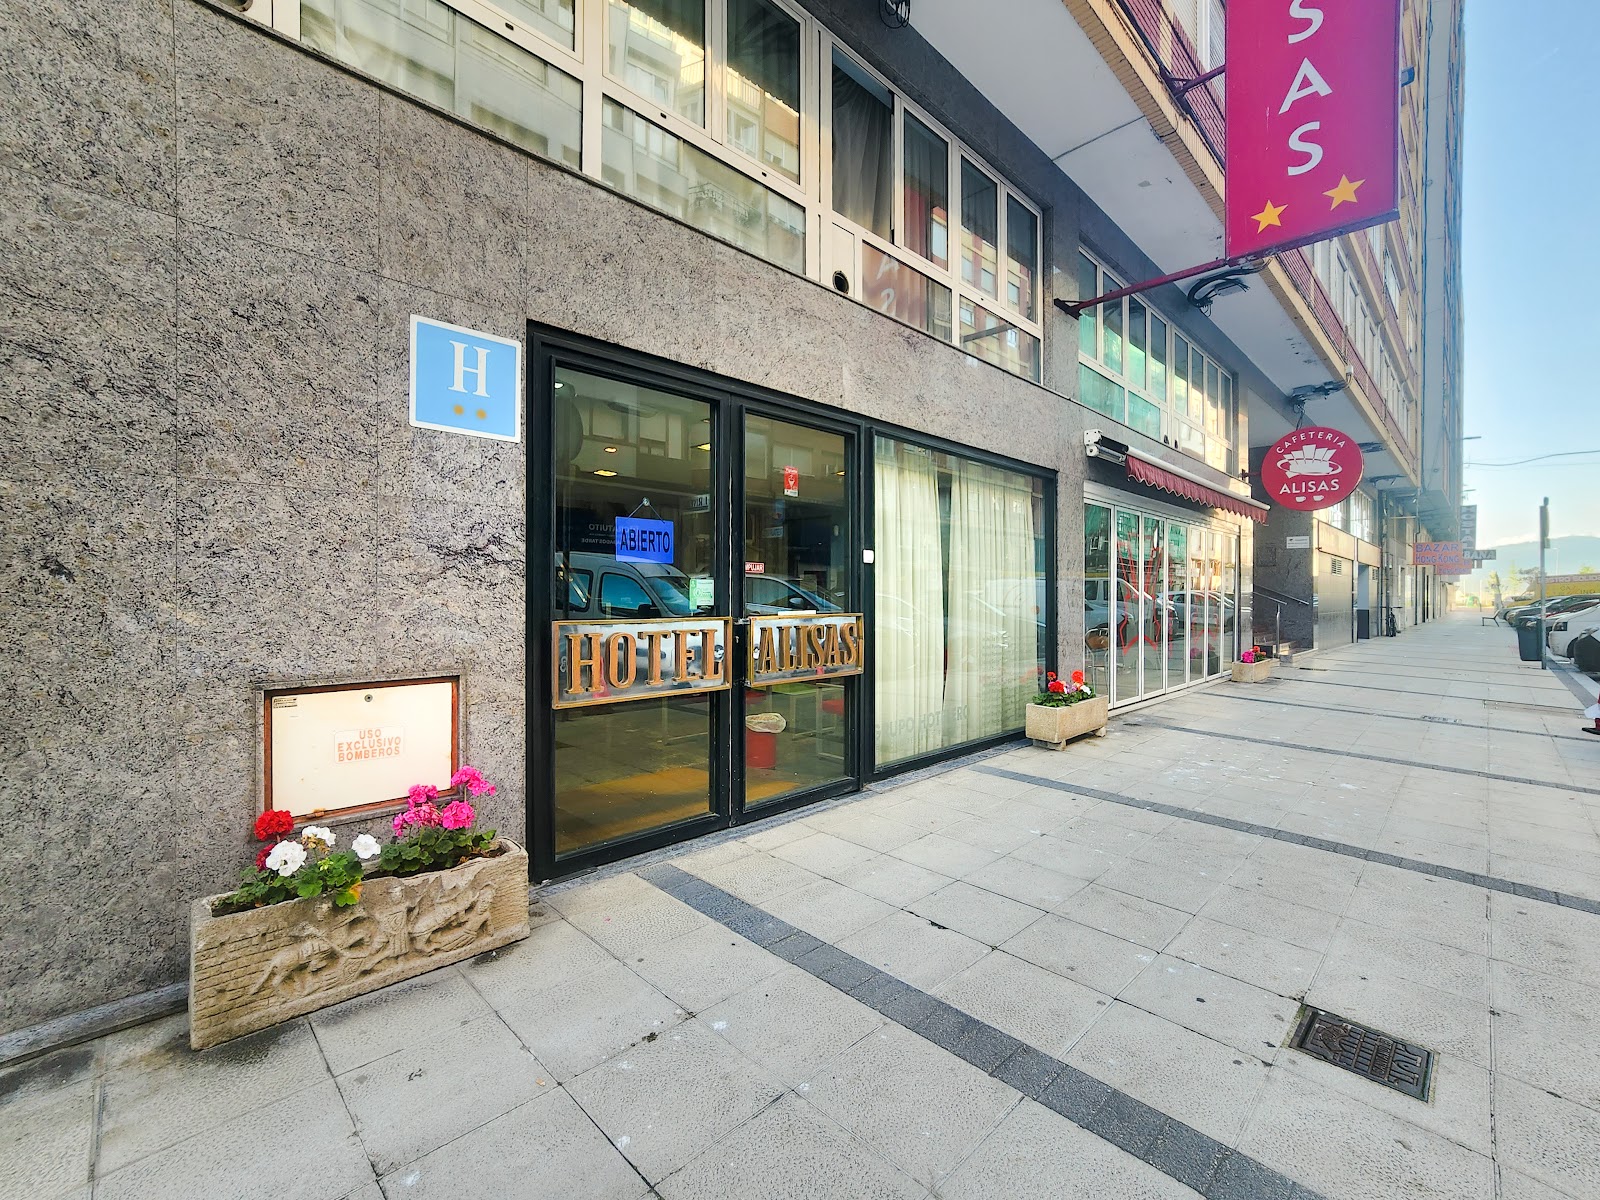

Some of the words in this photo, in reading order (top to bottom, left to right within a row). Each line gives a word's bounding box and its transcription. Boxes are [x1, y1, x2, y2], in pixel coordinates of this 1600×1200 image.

[448, 340, 491, 398] H
[1276, 431, 1346, 454] CAFETERIA
[1279, 479, 1340, 495] ALISAS
[1461, 506, 1475, 549] HOSTAL
[620, 528, 671, 553] ABIERTO
[1415, 543, 1459, 553] BAZAR
[564, 629, 723, 694] HOTEL
[758, 622, 860, 675] ALISAS
[337, 736, 402, 752] EXCLUSIVO
[359, 729, 382, 740] USO
[338, 746, 400, 762] BOMBEROS
